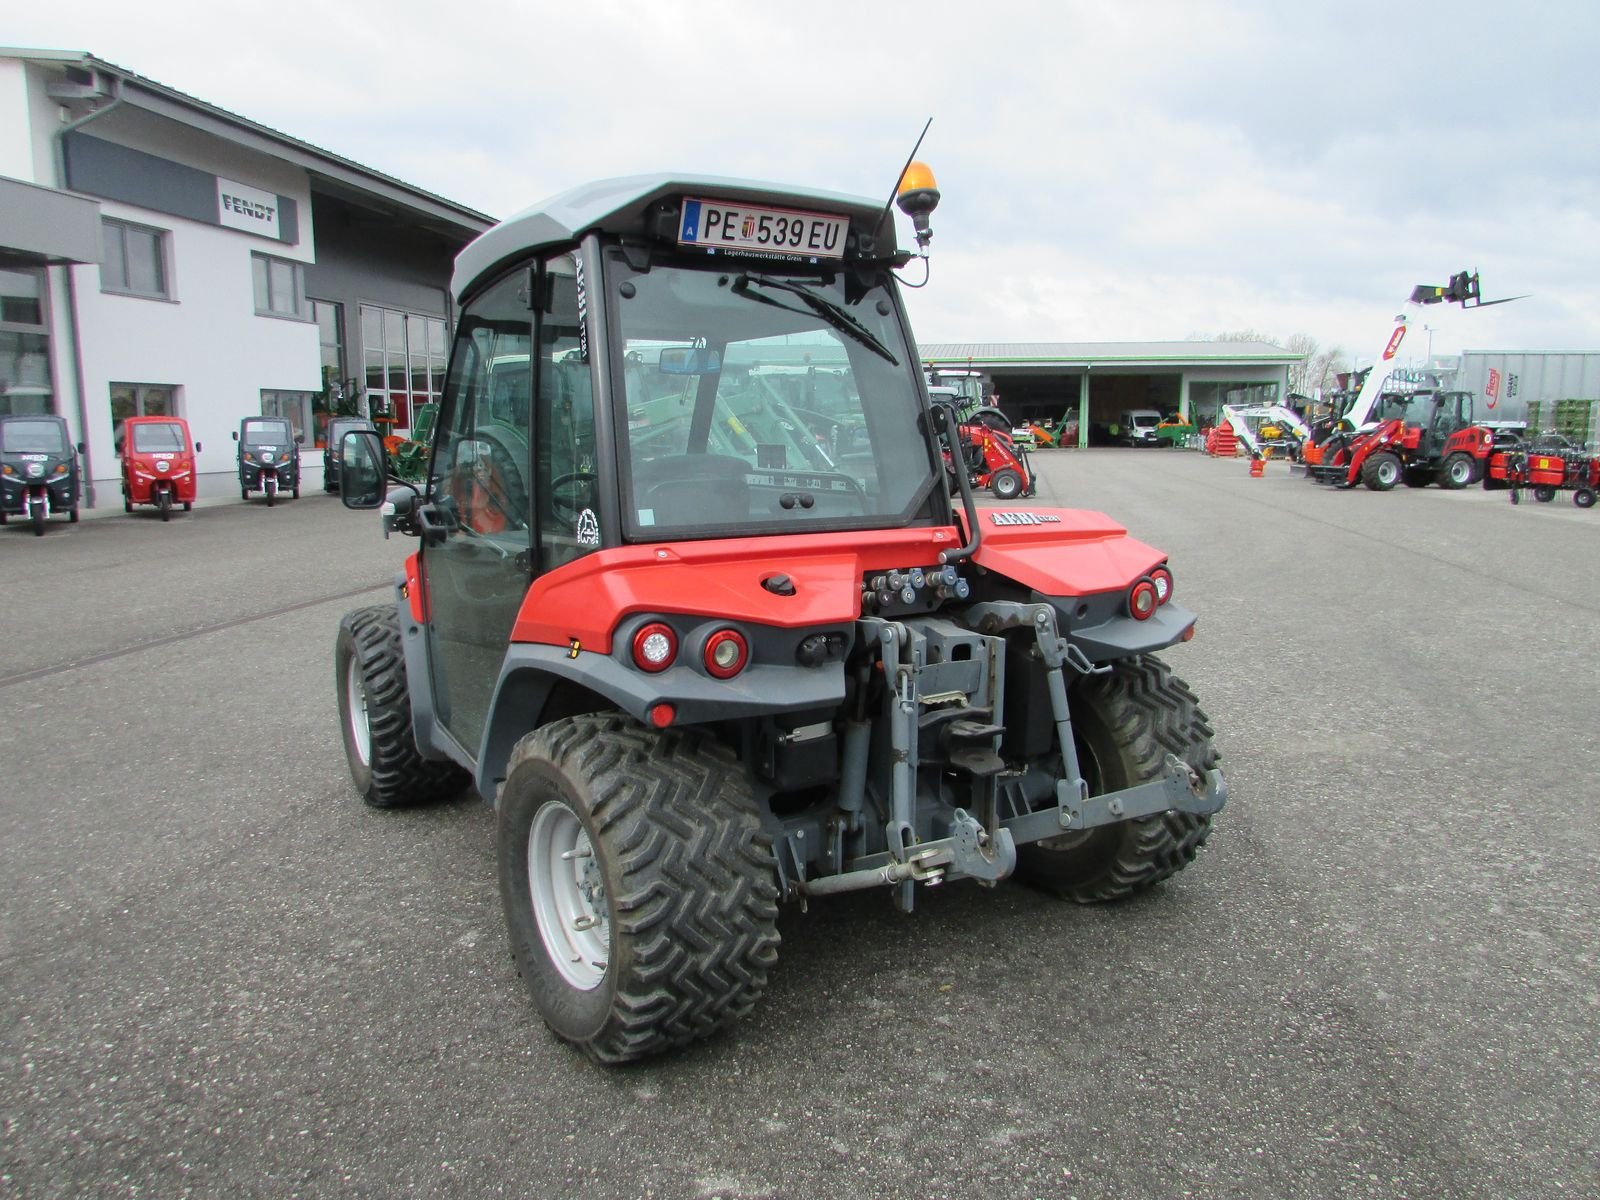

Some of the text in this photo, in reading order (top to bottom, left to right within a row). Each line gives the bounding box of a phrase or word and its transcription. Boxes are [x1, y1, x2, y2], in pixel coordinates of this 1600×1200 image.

[222, 194, 275, 222] FENDT
[686, 227, 694, 236] A
[704, 209, 840, 250] PE 539 EU
[724, 248, 803, 262] Lagerhauswerkstätte Grein
